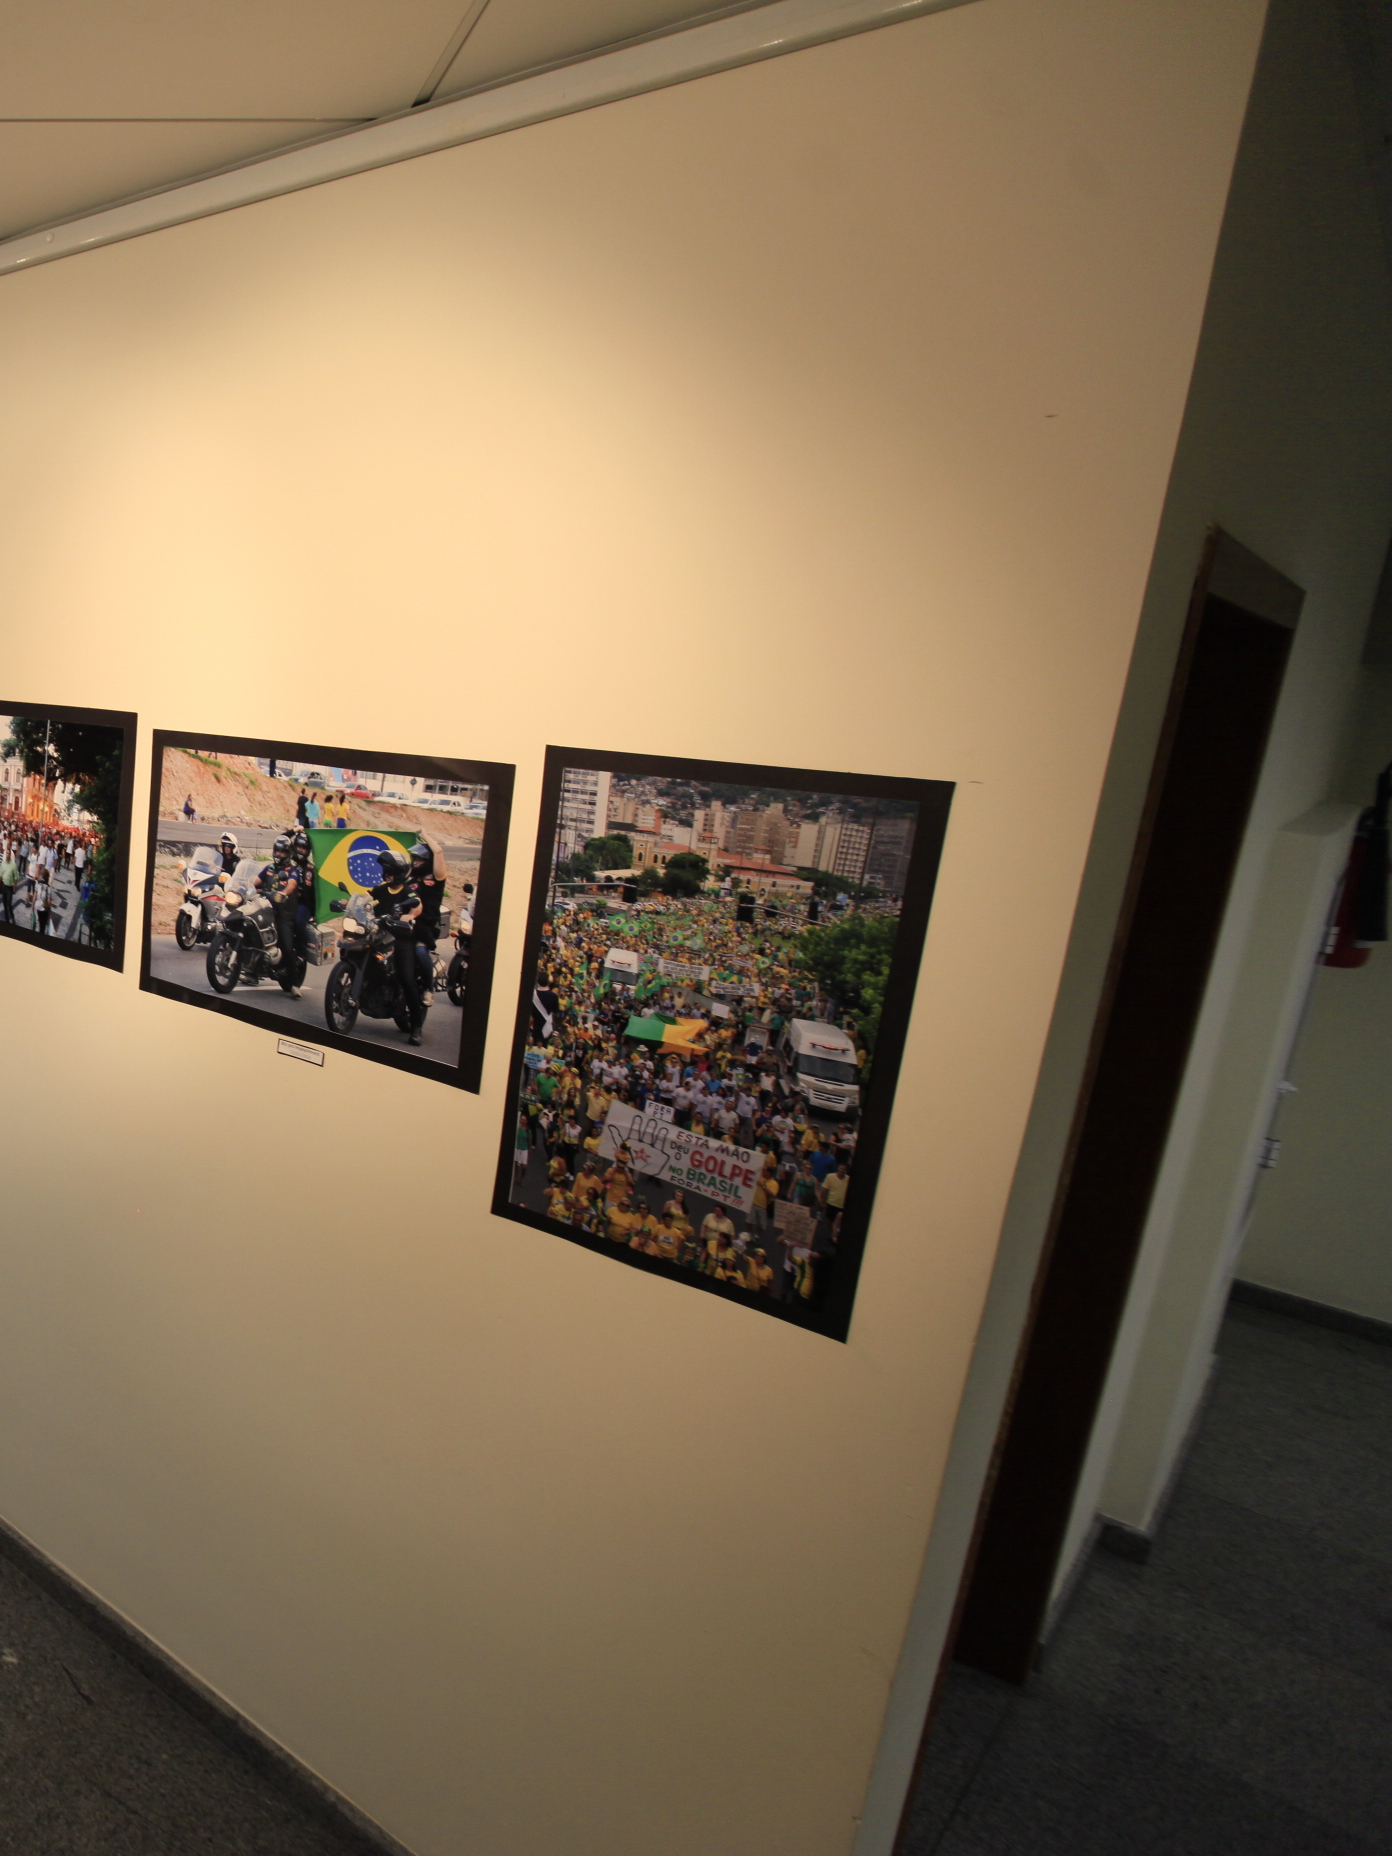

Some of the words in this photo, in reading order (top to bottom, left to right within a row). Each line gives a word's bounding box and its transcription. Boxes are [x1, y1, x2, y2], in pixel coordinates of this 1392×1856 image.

[676, 1130, 710, 1150] ESTA
[668, 1164, 683, 1177] NO
[686, 1168, 742, 1199] BRASIL
[690, 1150, 756, 1189] GOLPE
[670, 1175, 704, 1193] FORA
